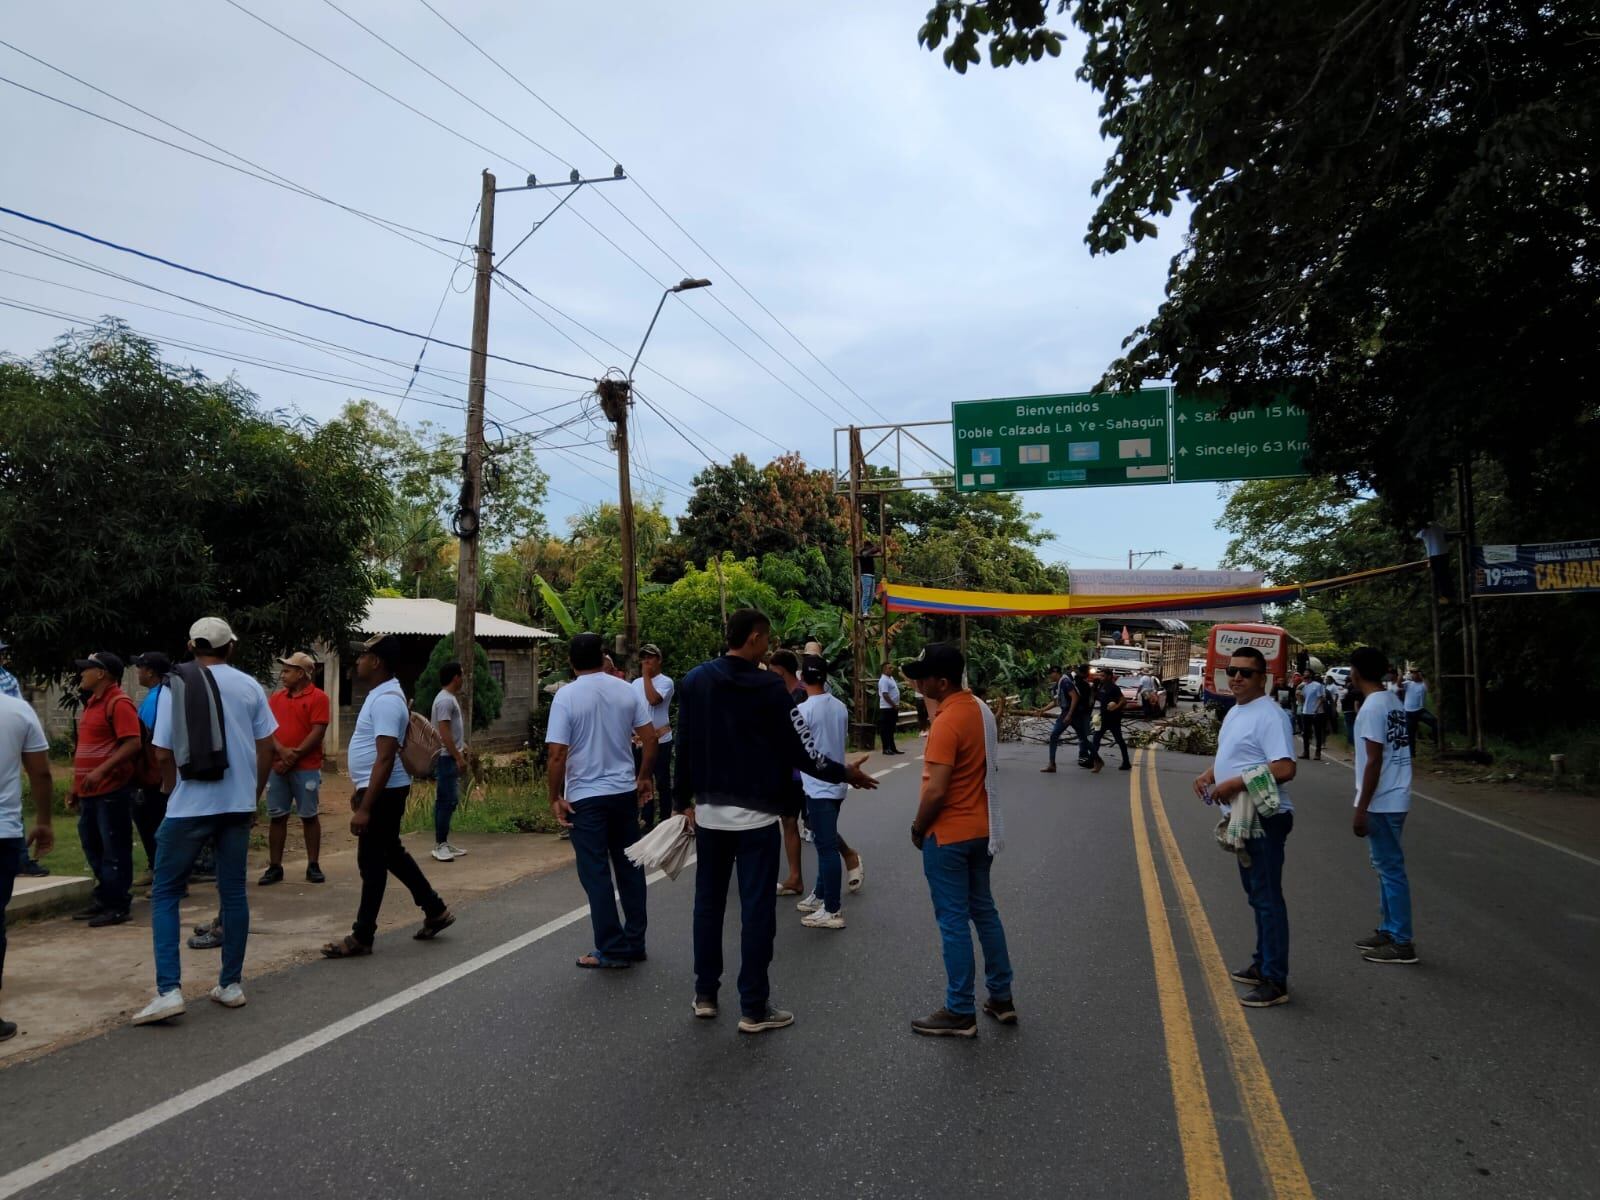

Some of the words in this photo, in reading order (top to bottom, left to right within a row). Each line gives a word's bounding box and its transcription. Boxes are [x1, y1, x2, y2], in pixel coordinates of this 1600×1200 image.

[1016, 402, 1100, 417] Bienvenidos
[1265, 406, 1283, 418] 15
[958, 428, 993, 439] Doble
[999, 424, 1051, 436] Calzada
[1056, 422, 1072, 433] La
[1195, 443, 1258, 458] Sincelejo
[1262, 441, 1283, 452] 63
[1484, 567, 1501, 586] 19
[1221, 634, 1249, 645] flecha
[1251, 638, 1274, 648] BUS
